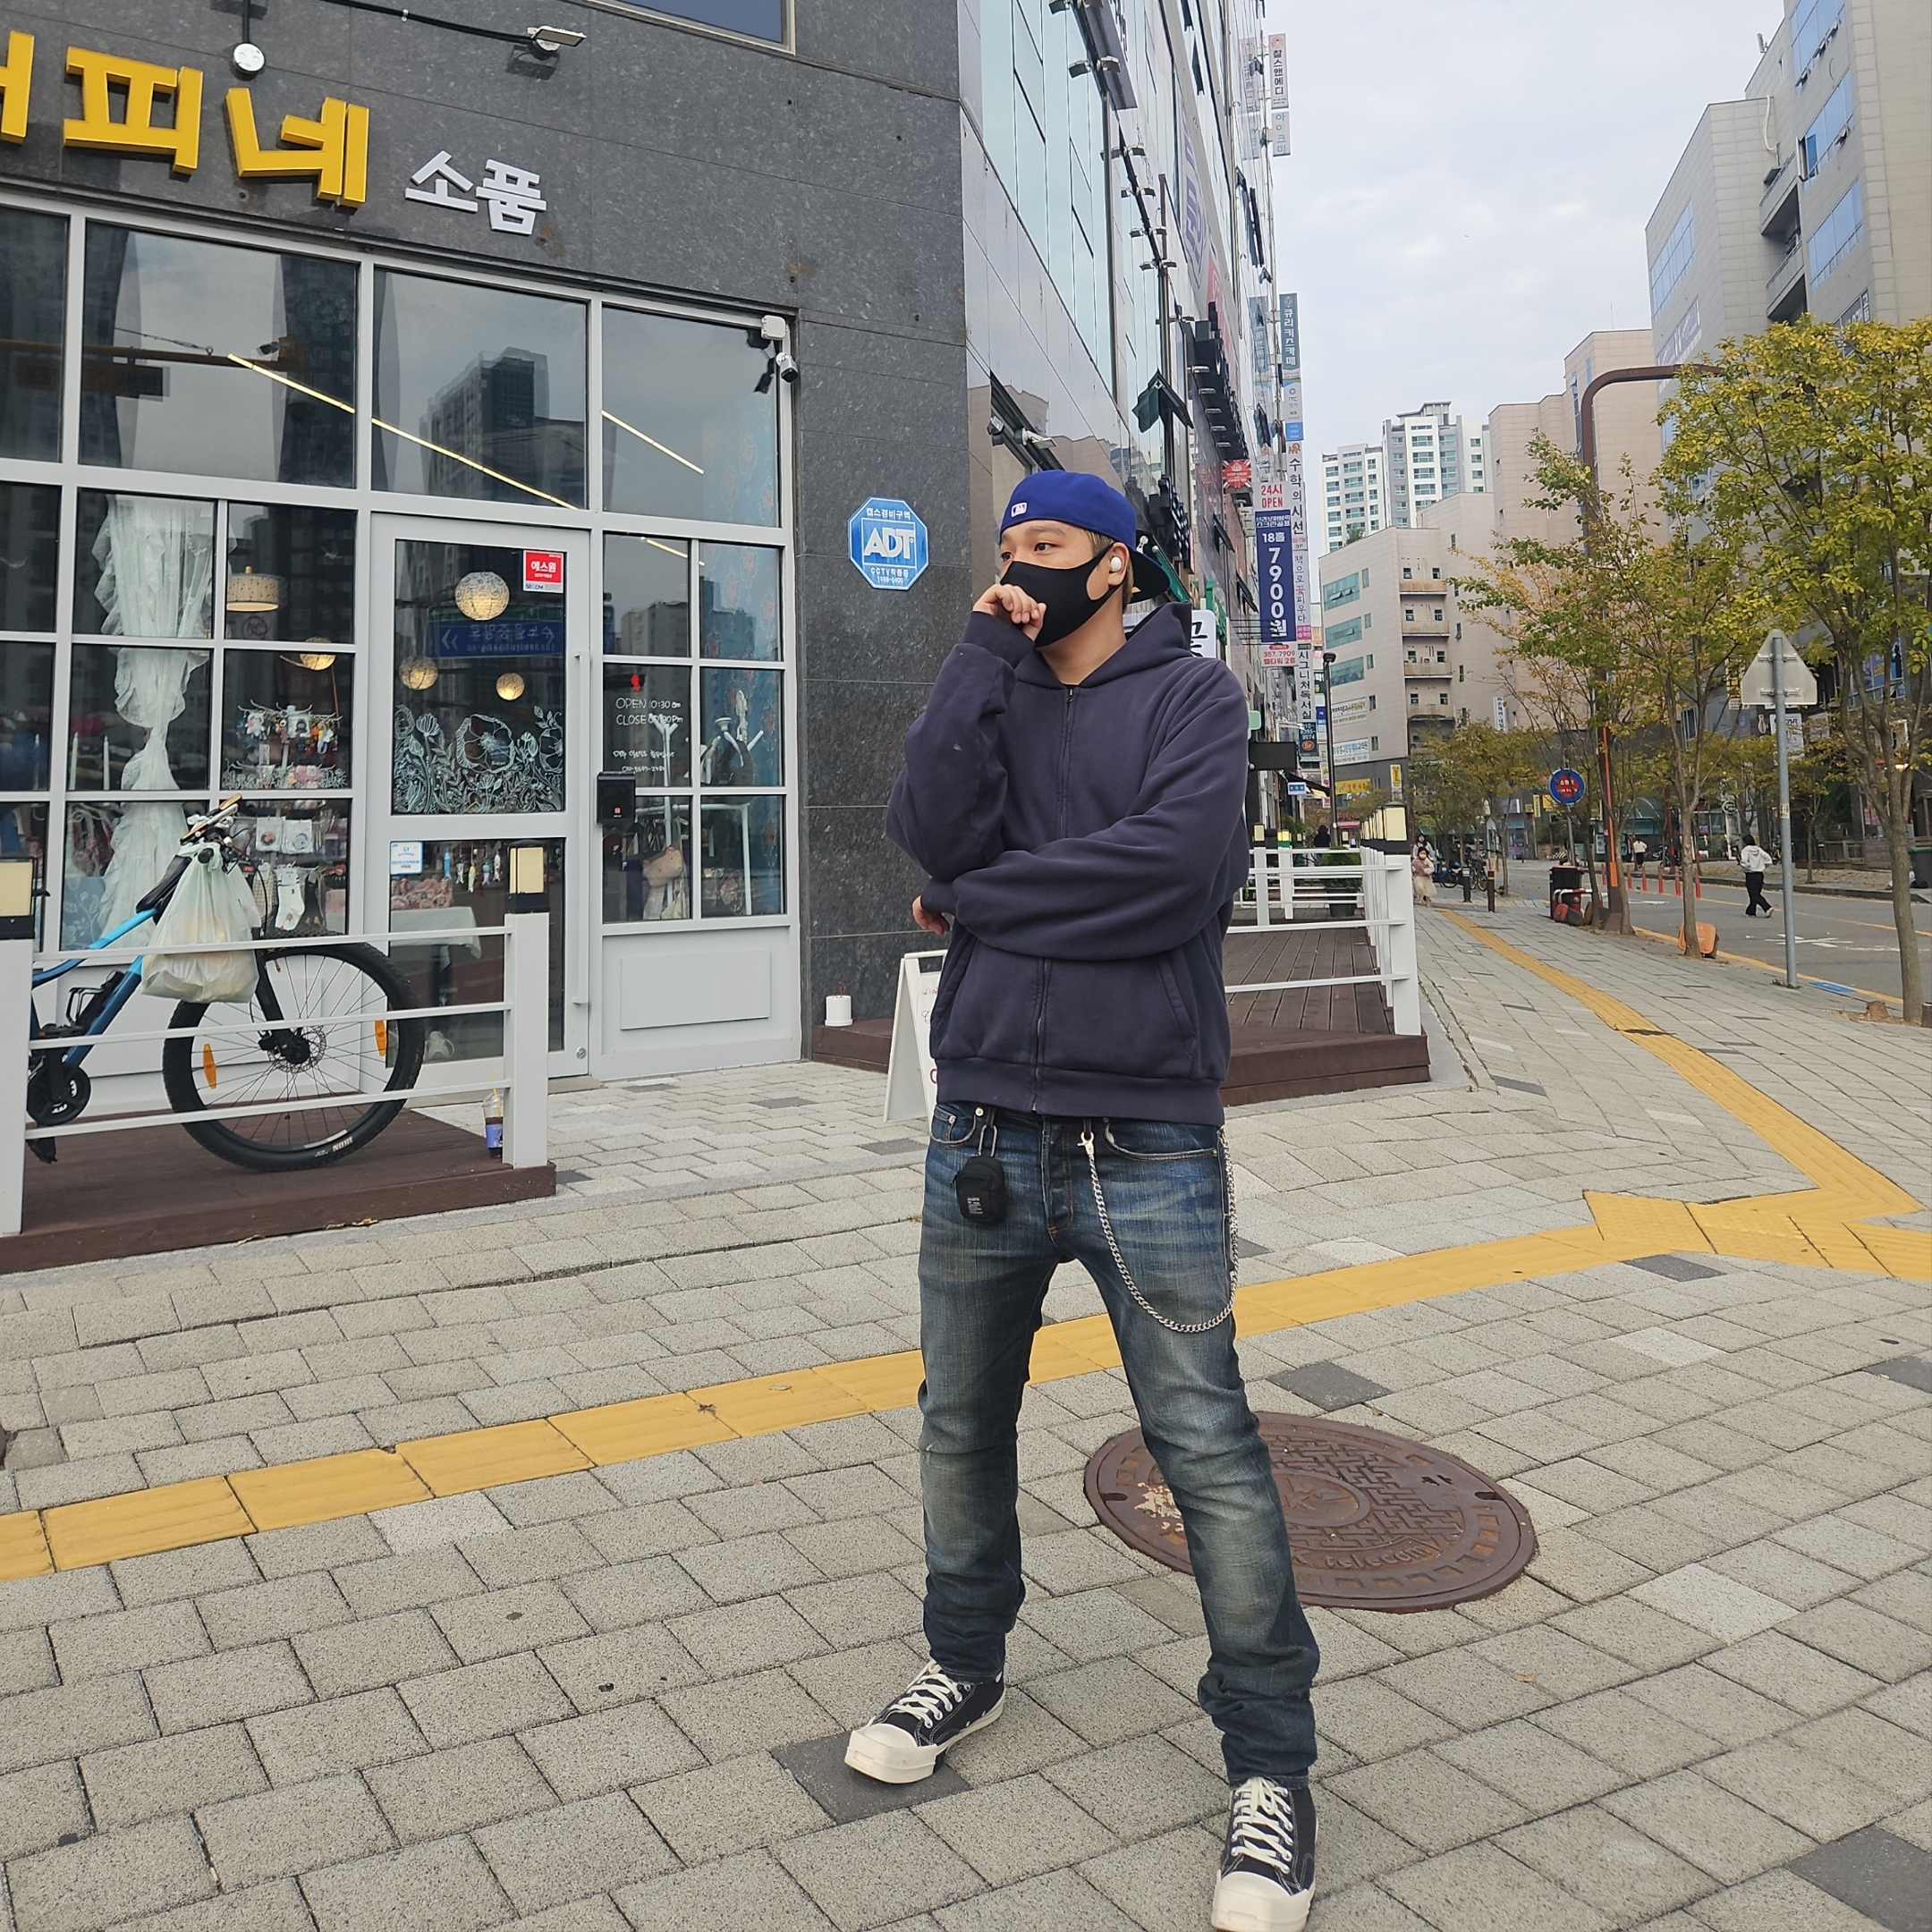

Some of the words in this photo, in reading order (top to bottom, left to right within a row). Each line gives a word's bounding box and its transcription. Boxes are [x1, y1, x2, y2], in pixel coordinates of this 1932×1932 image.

[404, 148, 547, 236] 소품
[1260, 484, 1283, 496] 24시
[1261, 497, 1284, 509] OPEN
[863, 527, 915, 559] ADT
[1262, 531, 1285, 543] 18홀
[530, 560, 556, 573] 에스원
[615, 697, 647, 709] OPEN
[615, 714, 647, 726] CLOSE
[1324, 1546, 1433, 1569] telecom
